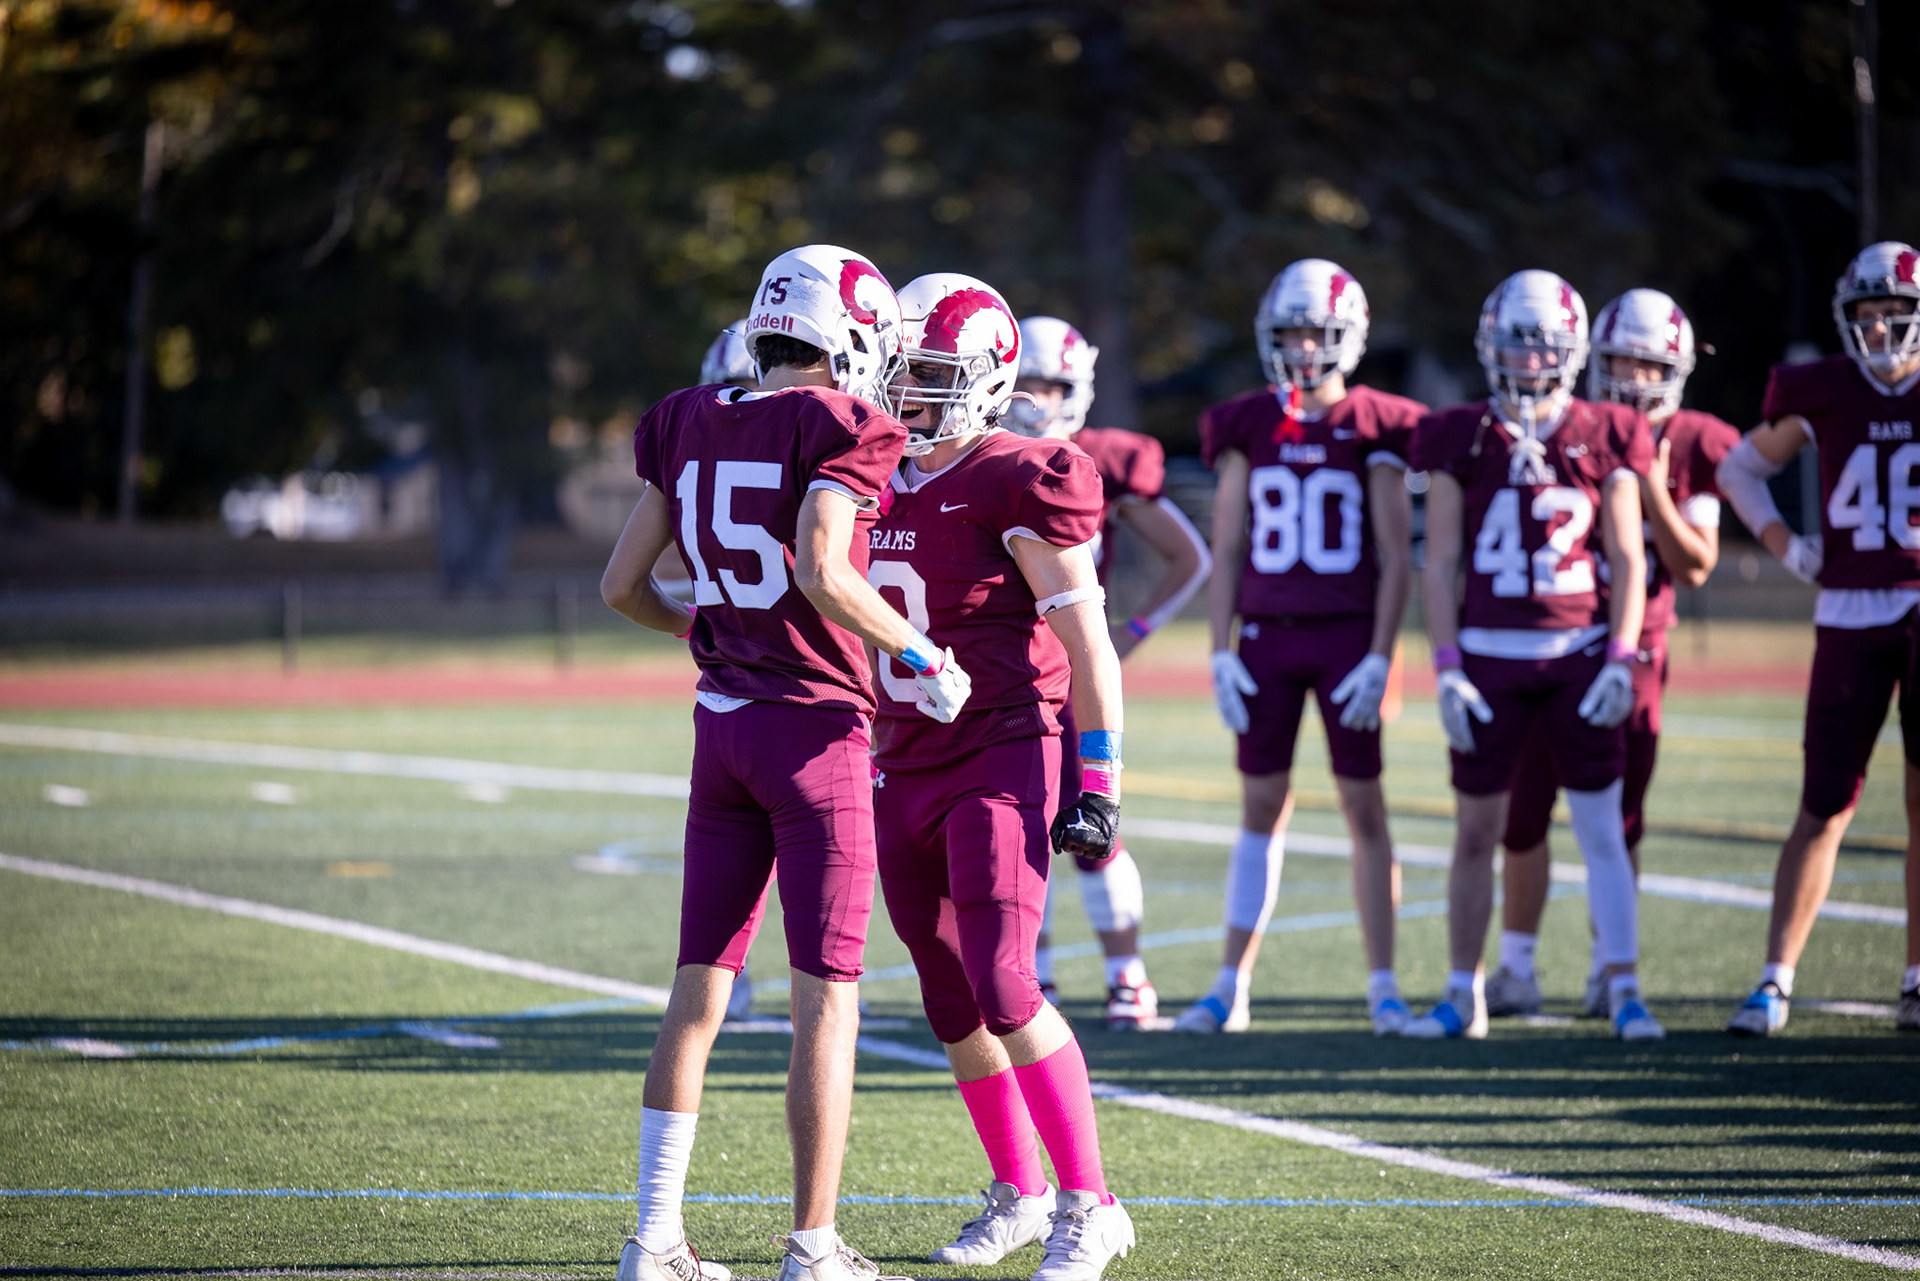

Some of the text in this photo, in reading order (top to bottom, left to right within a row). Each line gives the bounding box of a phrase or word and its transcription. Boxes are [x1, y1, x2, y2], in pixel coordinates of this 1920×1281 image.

[761, 277, 792, 306] 15
[676, 460, 789, 610] 15
[870, 529, 916, 551] RAMS
[1250, 466, 1363, 574] 80
[1473, 487, 1595, 598] 42
